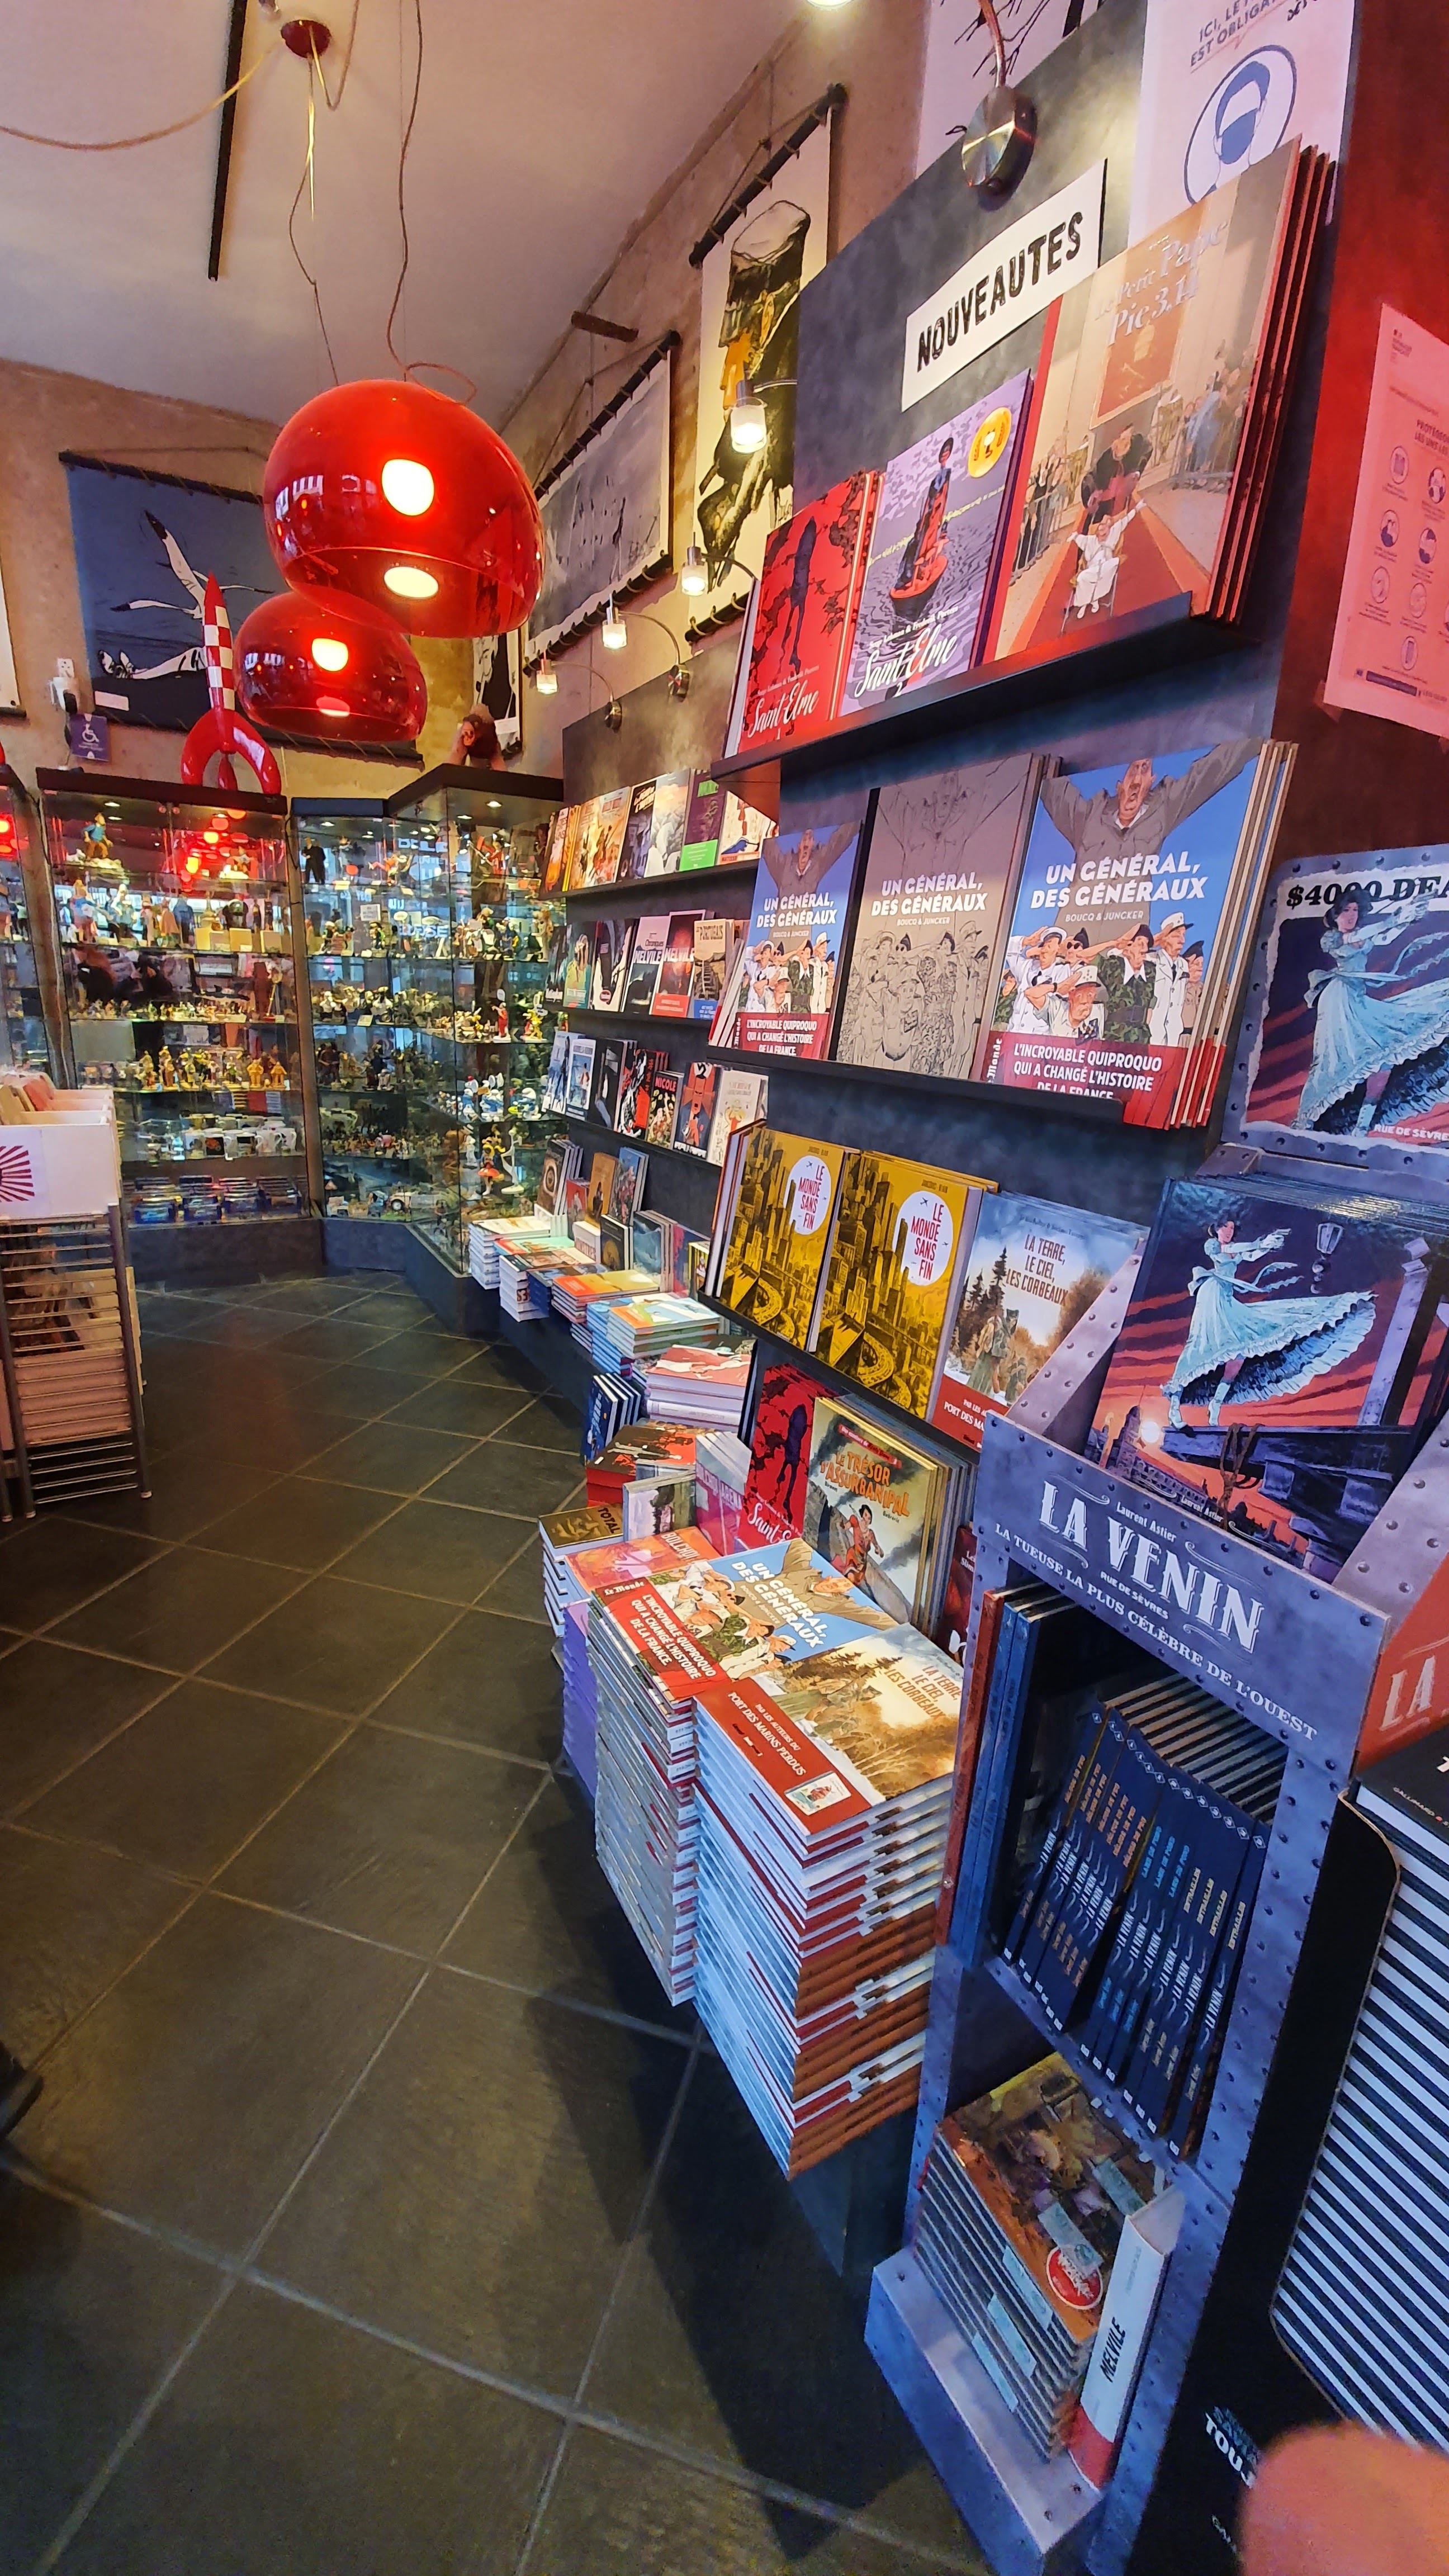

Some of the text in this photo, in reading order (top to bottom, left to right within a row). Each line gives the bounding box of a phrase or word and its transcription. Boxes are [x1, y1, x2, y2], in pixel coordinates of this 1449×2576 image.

[1191, 38, 1214, 67] EST
[1217, 0, 1276, 44] OBLIGA
[917, 212, 1084, 372] NOUVEAUTES
[1108, 302, 1149, 346] Pie
[893, 682, 903, 697] 2
[1045, 851, 1201, 884] UN GÉNÉRAL,
[882, 872, 983, 897] UN GÉNÉRAL,
[1030, 876, 1209, 909] DES GÉNÉRAUX
[764, 892, 834, 911] UN GÉNÉRAL,
[871, 893, 988, 916] DES GÉNÉRAUX
[756, 909, 837, 927] DES GÉNÉRAUX
[897, 918, 917, 926] BOUCQ
[923, 917, 950, 925] JUNCKER
[1065, 914, 1094, 922] BOUCQ
[1103, 910, 1144, 920] JUNCKER
[633, 950, 662, 964] MELVILE
[746, 1019, 817, 1031] L'INCROYABLE QUIPROQUO
[747, 1031, 814, 1044] QUI A CHANGÉ L'HISTOIRE
[766, 1045, 774, 1053] LA
[774, 1045, 797, 1055] FRANCE
[1014, 1043, 1162, 1072] L'INCROYABLE QUIPROQUO
[655, 1076, 677, 1092] NICOLE
[1014, 1060, 1154, 1092] QUI A CHANGÉ L'HISTOIRE
[1374, 1124, 1449, 1141] RUE DE SÈVRE
[816, 1164, 825, 1181] LE
[798, 1177, 822, 1197] MONDE
[801, 1195, 818, 1214] SANS
[932, 1203, 944, 1223] LE
[803, 1213, 815, 1230] FIN
[910, 1216, 941, 1242] MONDE
[915, 1238, 936, 1262] SANS
[1025, 1234, 1066, 1266] LA TERRE,
[919, 1259, 934, 1281] FIN
[1025, 1255, 1055, 1283] LE CIEL,
[1006, 1268, 1068, 1306] LES CORBEAUX
[944, 1401, 973, 1424] PORT DES
[835, 1452, 891, 1487] LE TRÉSOR
[820, 1461, 910, 1517] D'ASSURBANIPAL
[598, 1507, 621, 1534] TOTAL
[1116, 1501, 1177, 1542] Laurent Astier
[1204, 1505, 1224, 1523] Astier
[960, 1556, 974, 1572] Slim
[1039, 1480, 1265, 1654] LA VENIN
[614, 1581, 645, 1593] Monde
[752, 1562, 775, 1580] UN
[769, 1580, 828, 1637] GÉNÉRAL,
[1100, 1571, 1169, 1620] RUE DE SÈVRES
[731, 1561, 824, 1648] DES GÉNÉRAUX
[630, 1618, 673, 1666] DE LA FRANCE
[631, 1599, 647, 1614] QUI
[645, 1617, 674, 1645] CHANGÉ
[665, 1641, 702, 1680] L'HISTOIRE
[642, 1594, 716, 1677] L'INCROYABLE QUIPROQUO
[995, 1523, 1318, 1741] LA TUEUSE LA PLUS CÉLÈBRE DE L'OUEST
[884, 1669, 946, 1720] LES CORBEAUX
[911, 1675, 944, 1702] LE CIEL,
[922, 1665, 939, 1676] LA
[933, 1674, 962, 1701] TERRE,
[1379, 1655, 1436, 1732] LA
[727, 1692, 747, 1710] PORT
[742, 1708, 759, 1723] DES
[754, 1721, 782, 1748] MARINS
[776, 1746, 806, 1776] PERDUS
[1100, 2316, 1126, 2383] MELVILE
